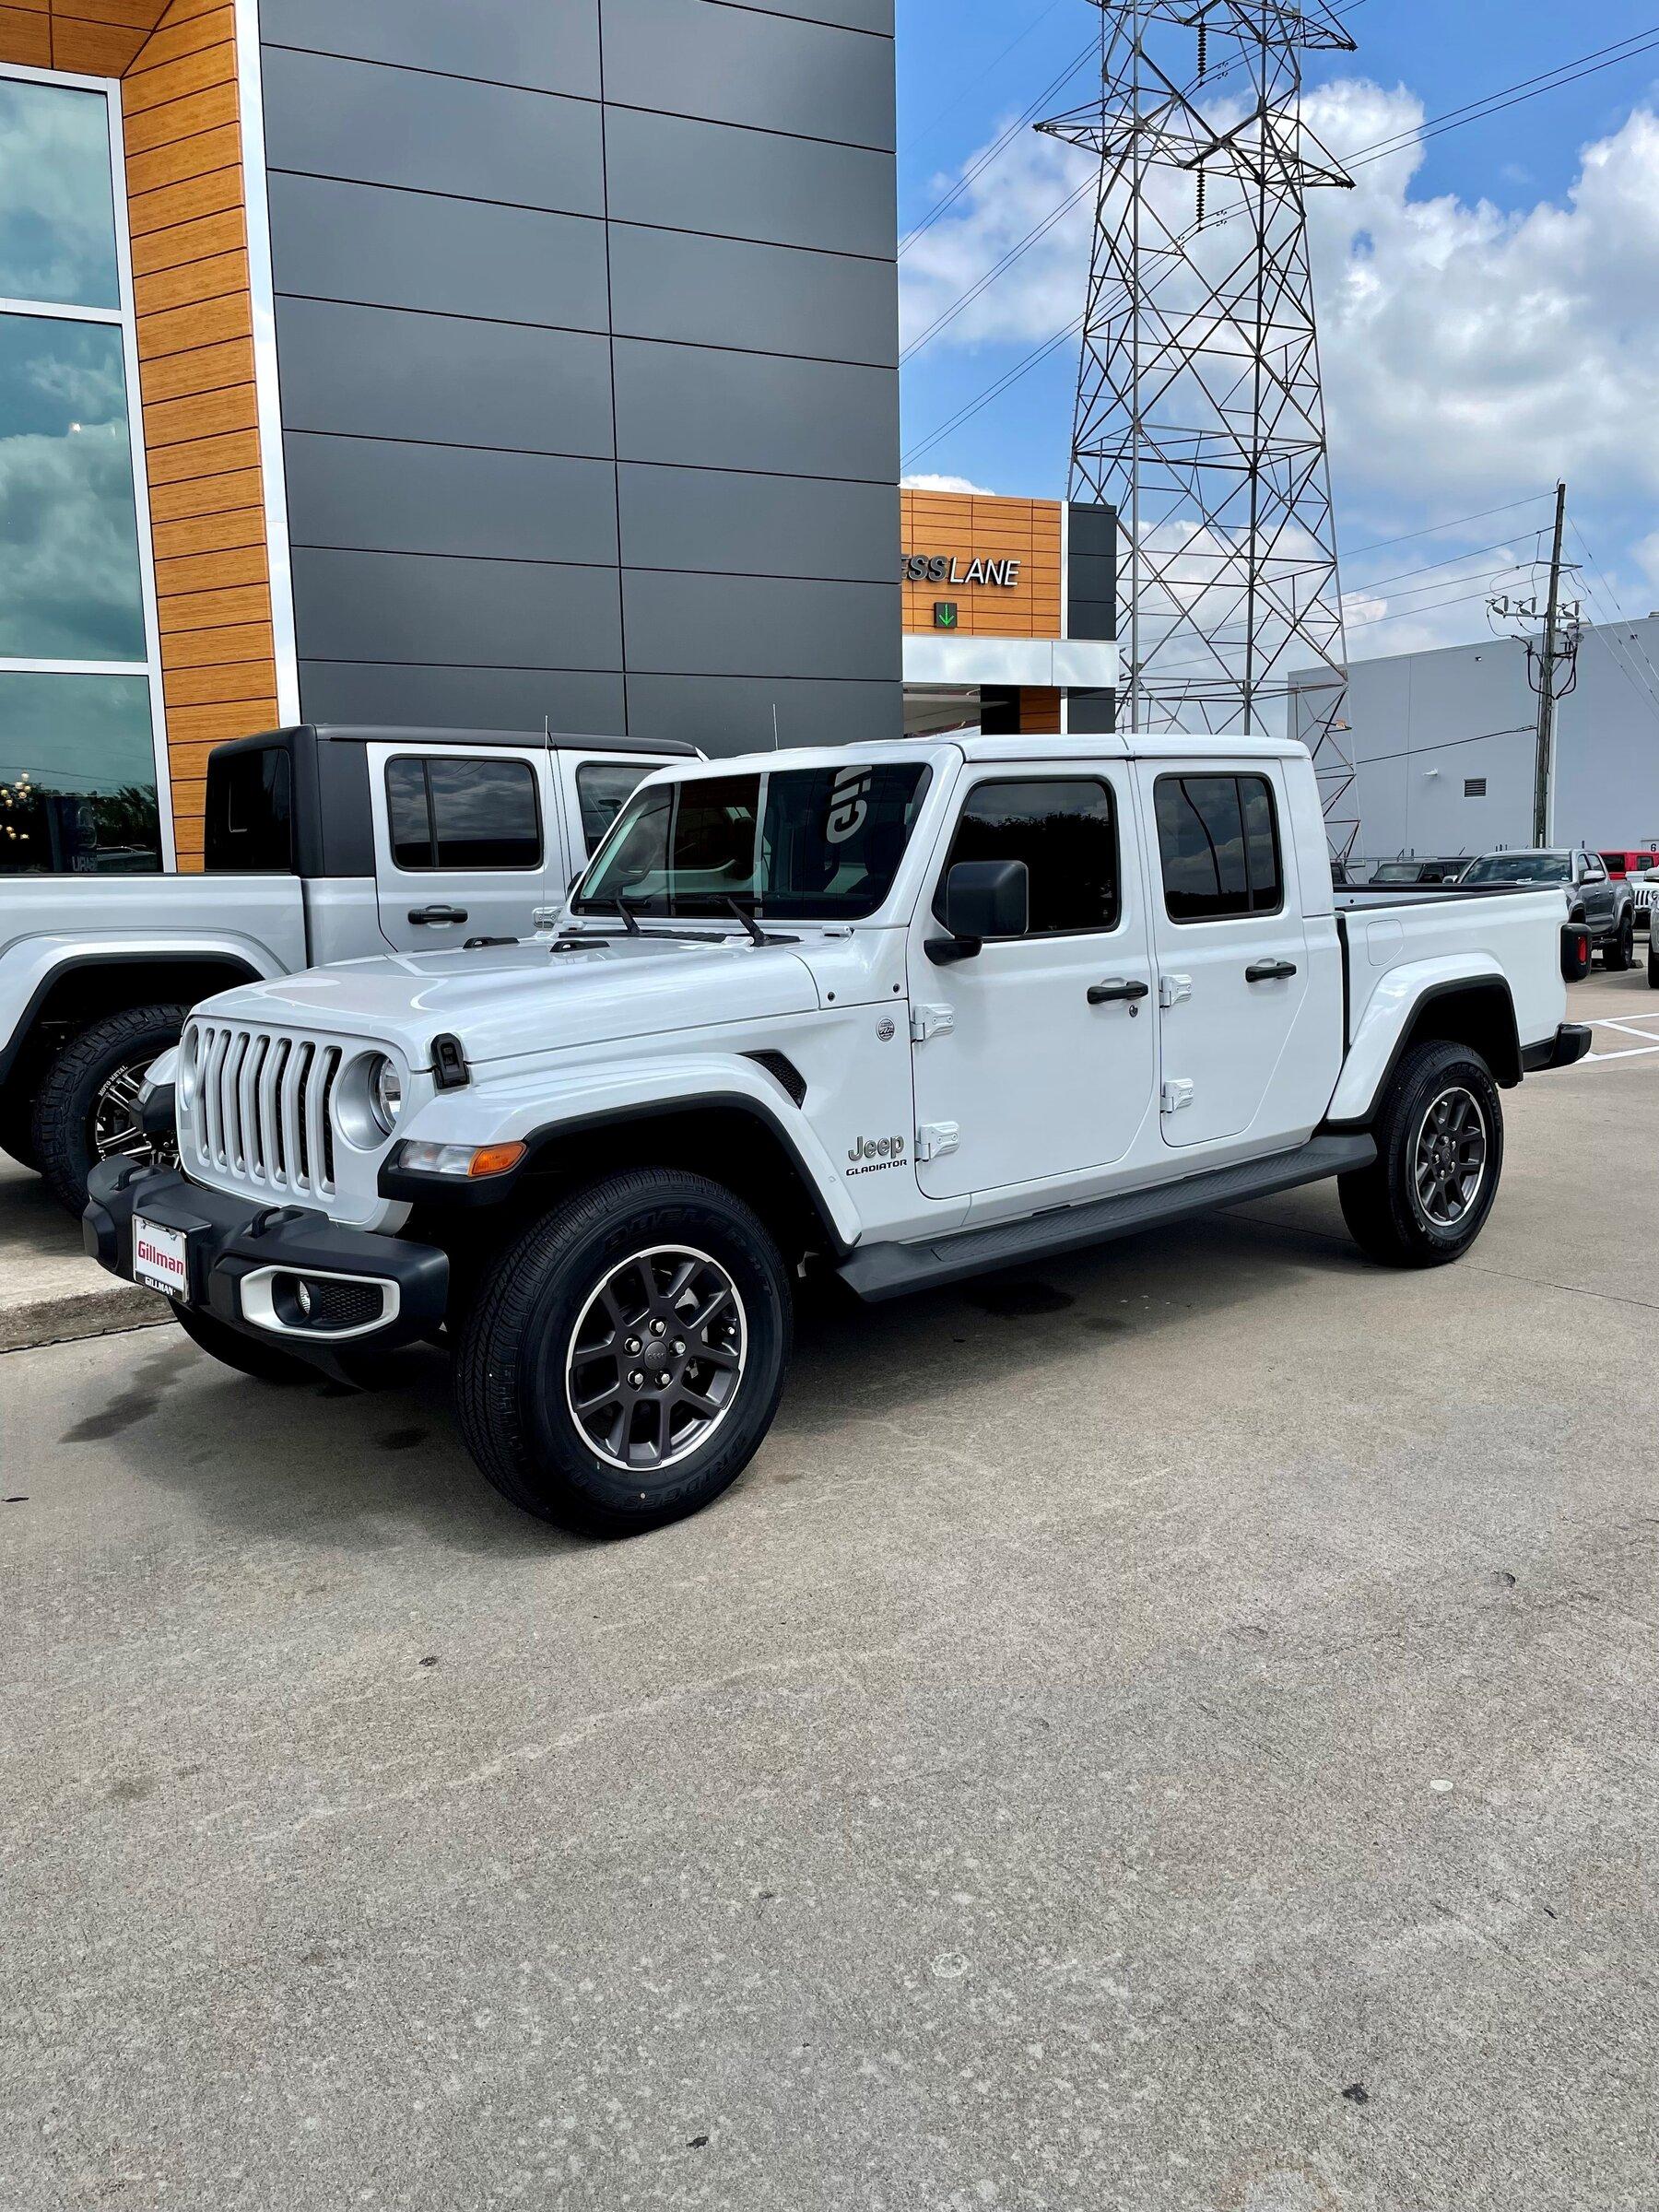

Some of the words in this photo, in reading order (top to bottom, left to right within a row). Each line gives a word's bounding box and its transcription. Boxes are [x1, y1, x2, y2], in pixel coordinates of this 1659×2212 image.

[1651, 844, 1657, 853] 6
[98, 1080, 112, 1097] MOTO
[109, 1065, 128, 1082] METAL
[848, 1135, 904, 1161] Jeep
[846, 1159, 908, 1176] GLADIATOR
[138, 1241, 184, 1276] Gillman
[145, 1277, 174, 1296] GILLMAN
